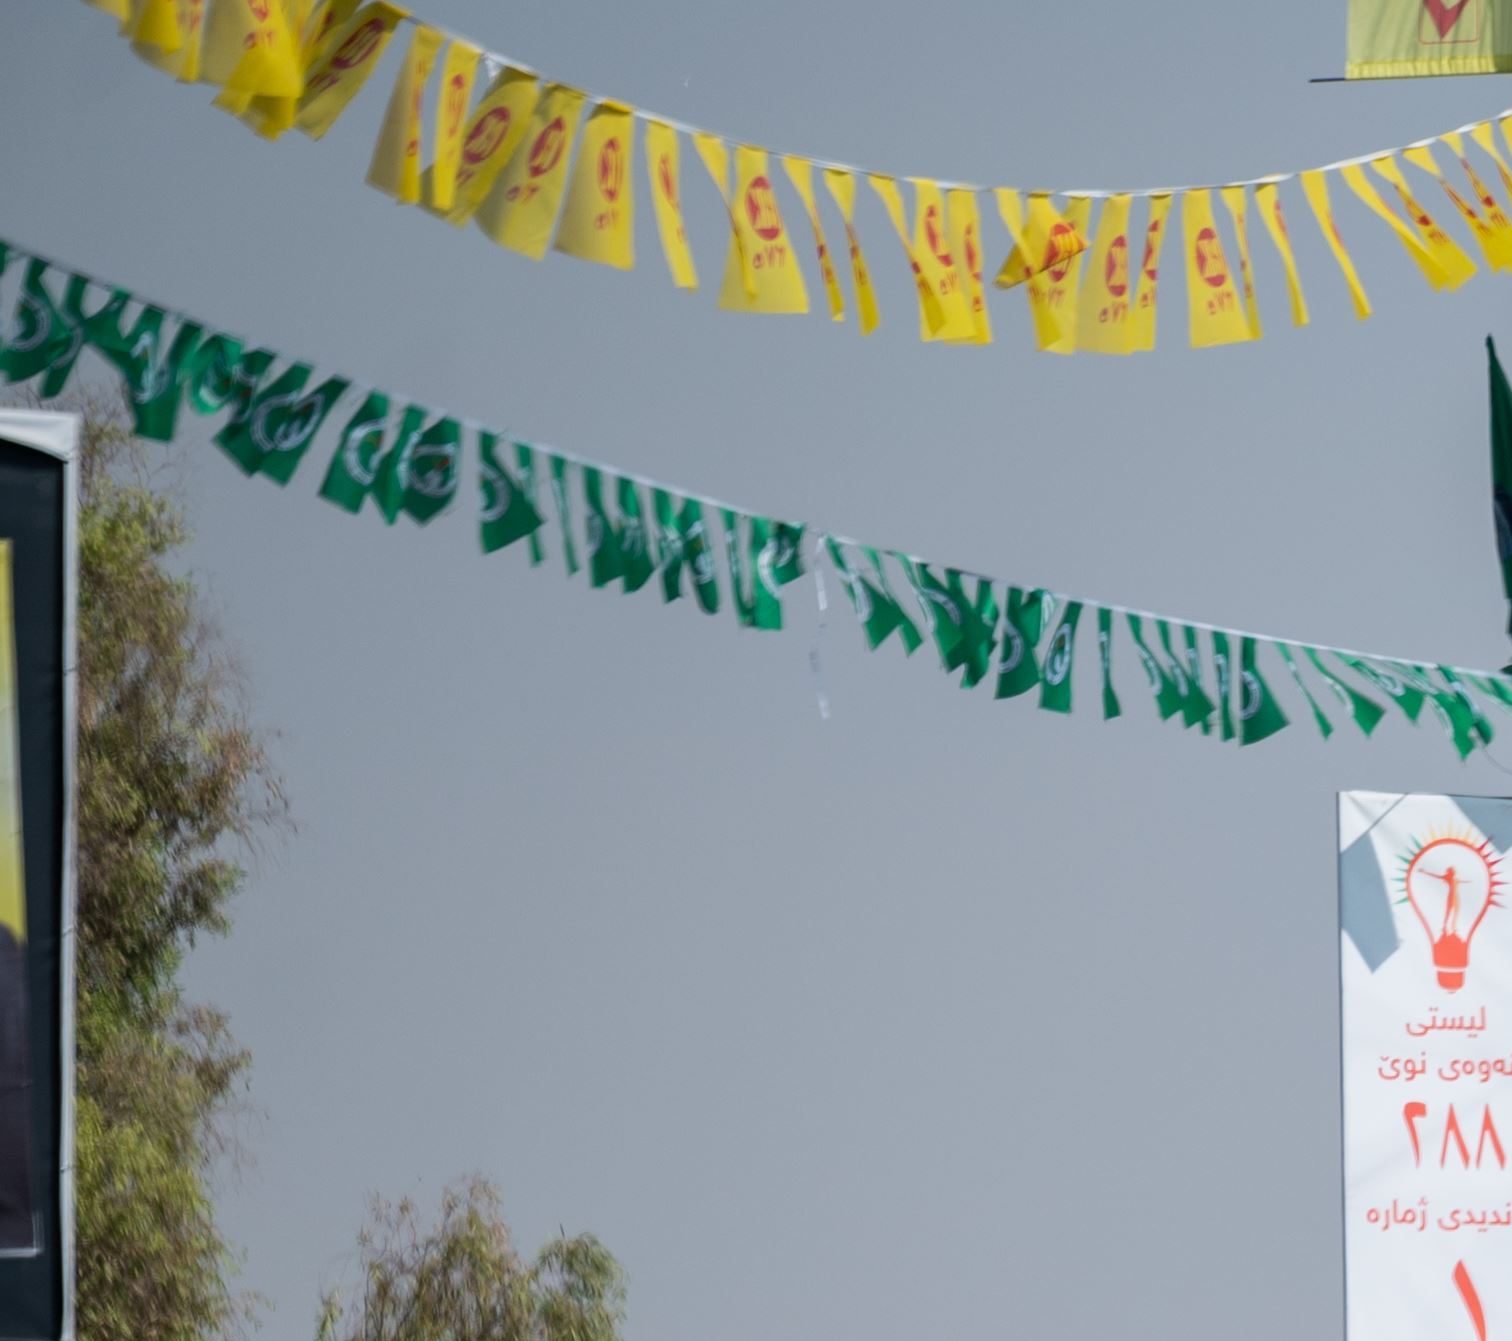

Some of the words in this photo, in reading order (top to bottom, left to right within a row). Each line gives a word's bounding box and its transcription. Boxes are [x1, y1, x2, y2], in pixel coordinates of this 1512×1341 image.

[1404, 1005, 1488, 1037] لیستی
[1377, 1049, 1428, 1083] نوێ
[1403, 1101, 1508, 1172] ٢٨٨
[1365, 1195, 1430, 1232] ژمارە
